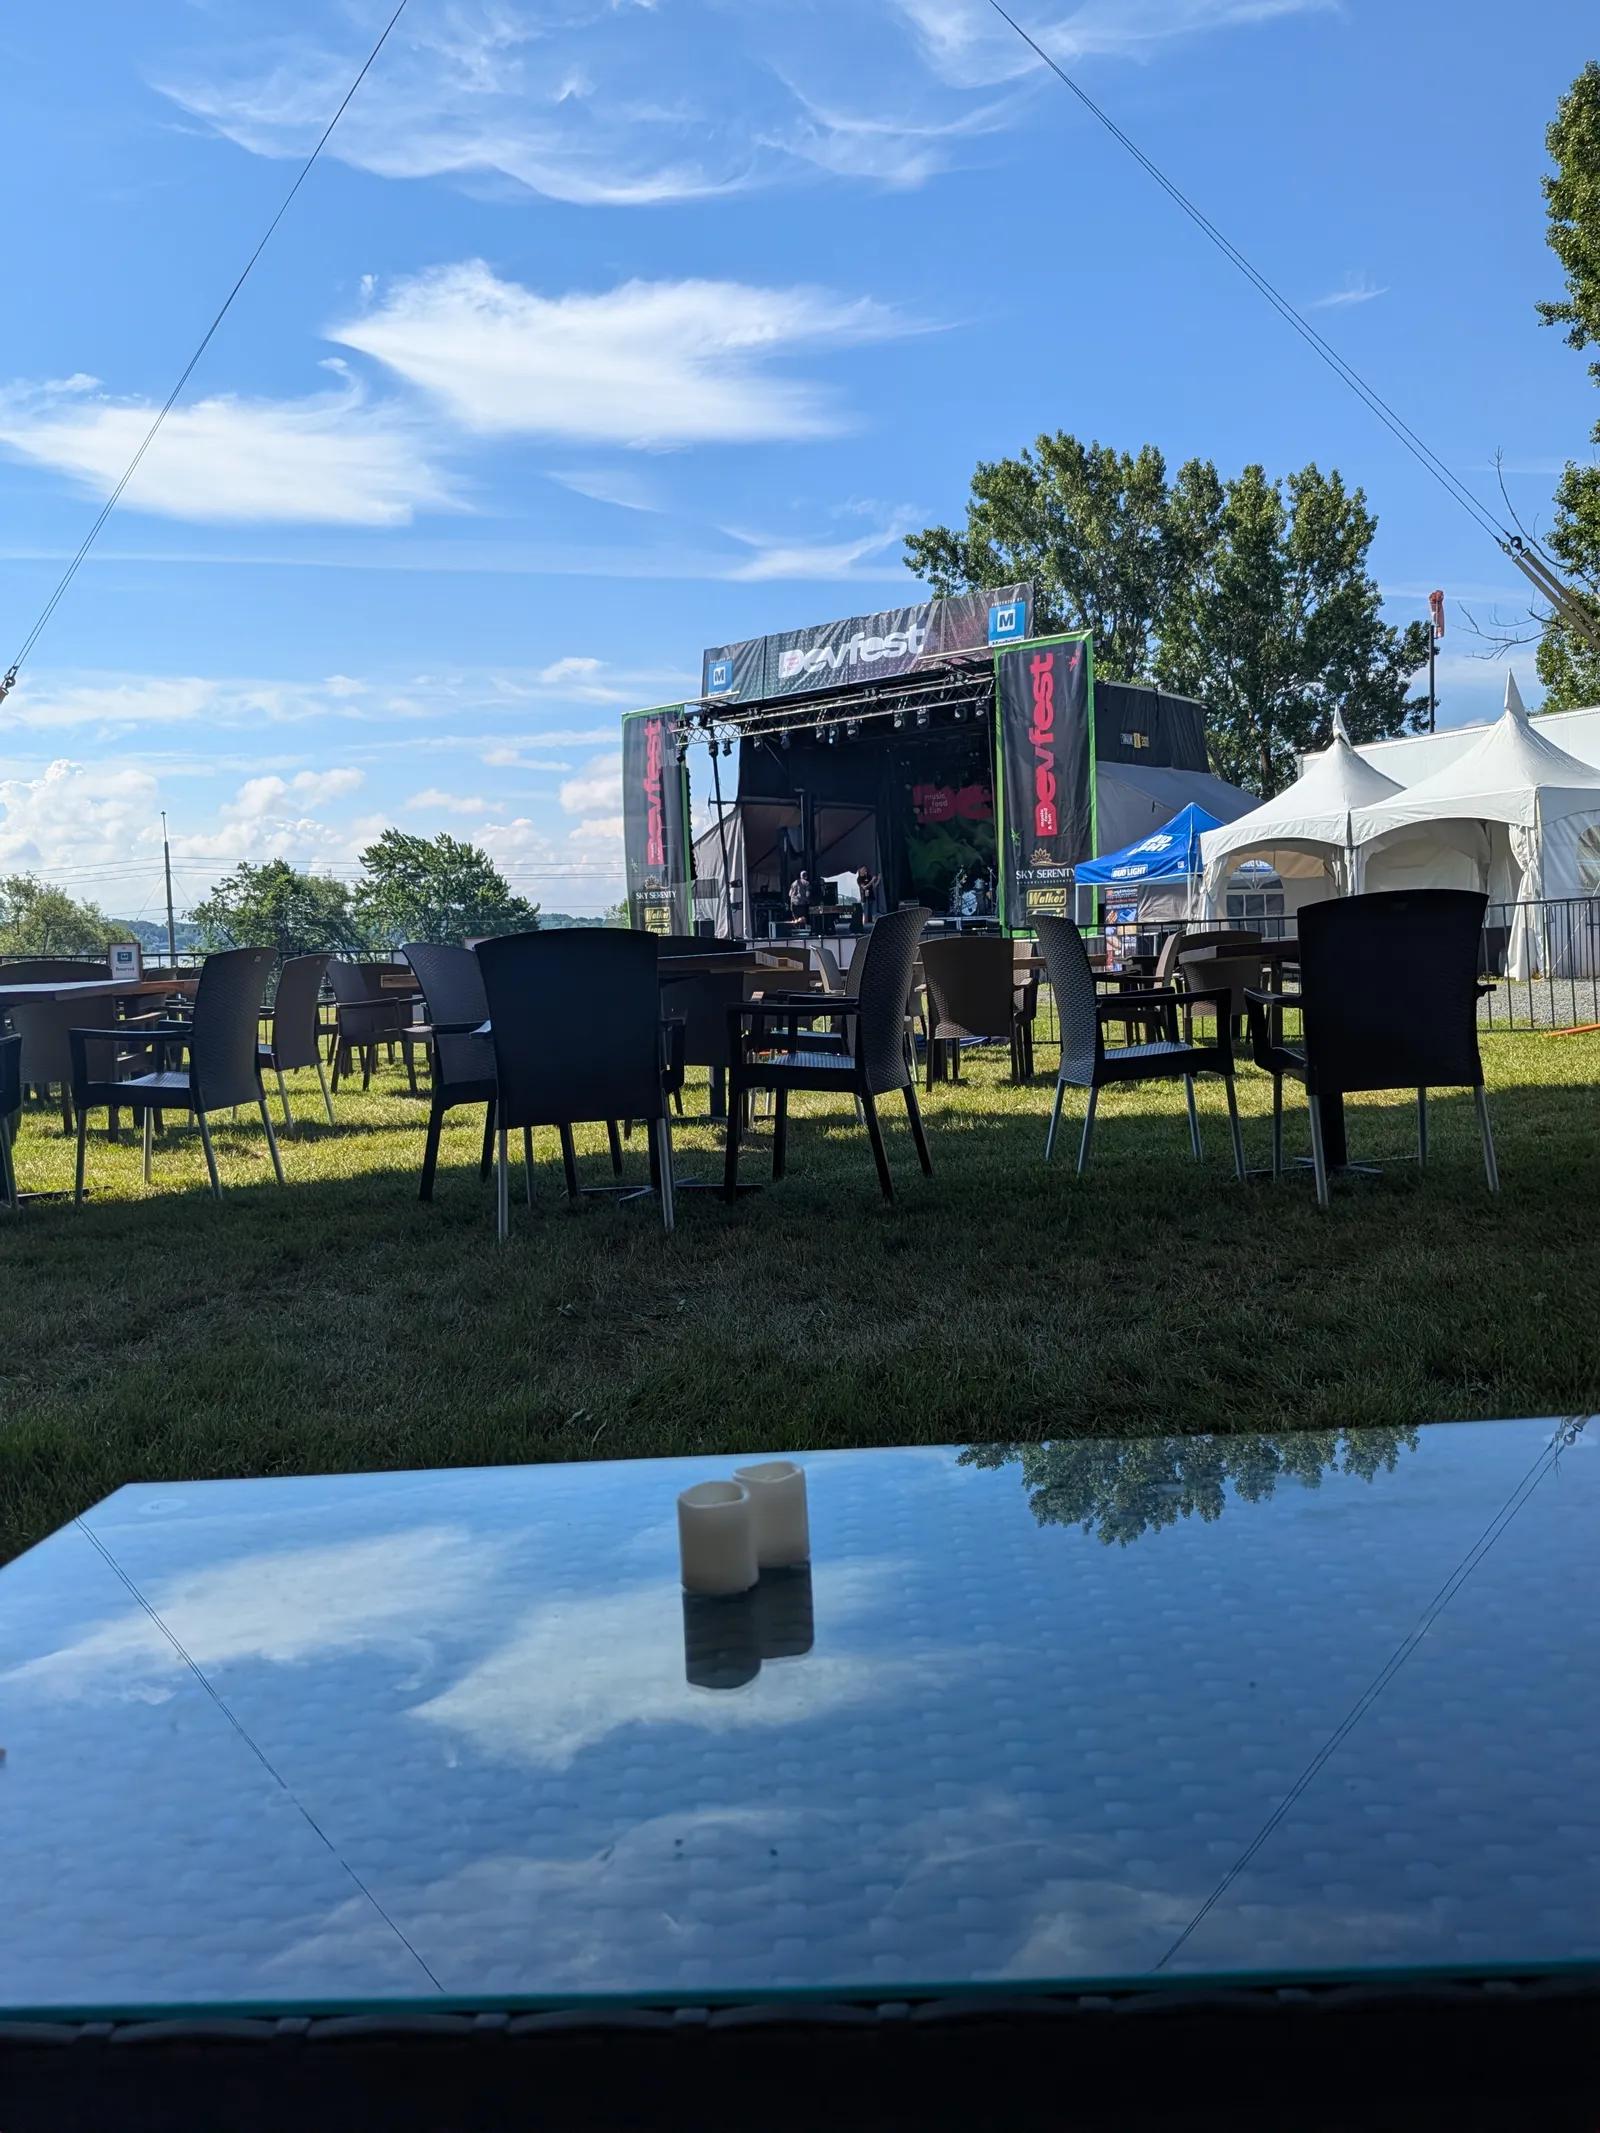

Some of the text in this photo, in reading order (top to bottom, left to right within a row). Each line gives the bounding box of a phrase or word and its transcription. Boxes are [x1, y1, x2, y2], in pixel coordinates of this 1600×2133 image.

[998, 612, 1014, 628] M
[714, 669, 725, 682] M
[1029, 652, 1058, 836] Devfest
[1016, 867, 1076, 880] SKY SERENITY
[1112, 866, 1147, 878] BUD LIGHT
[1029, 891, 1065, 905] Walker
